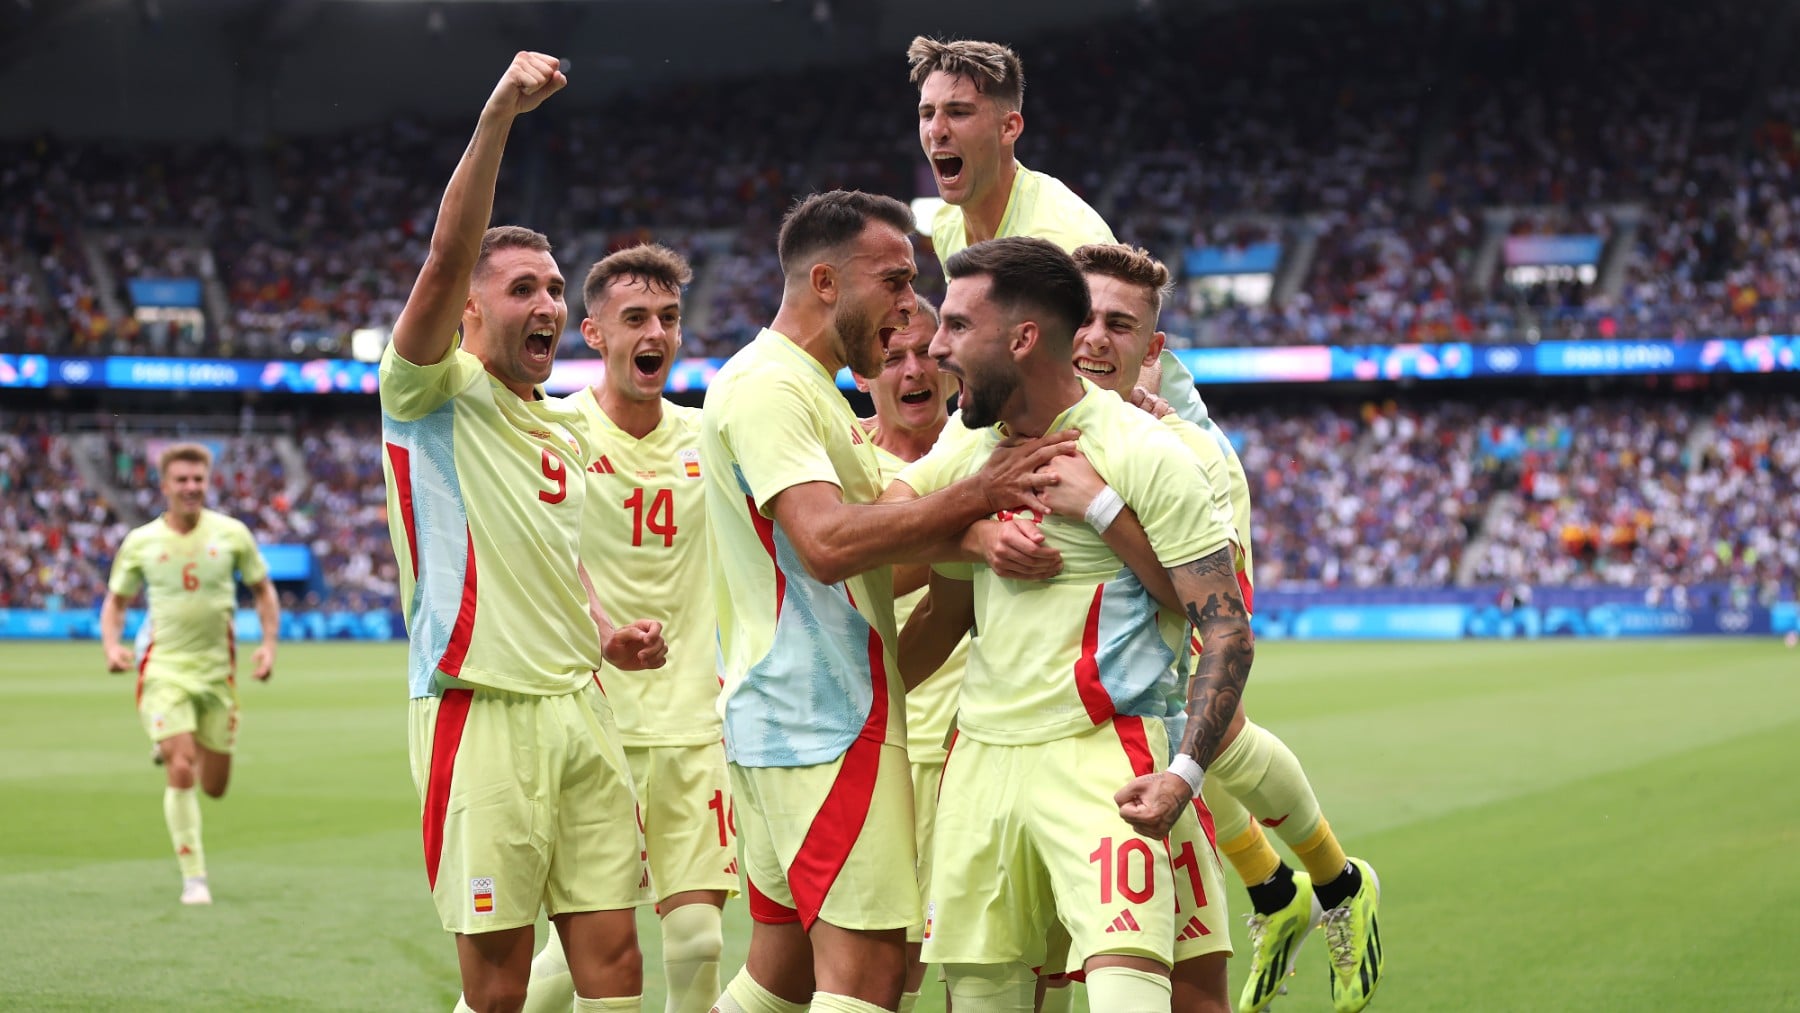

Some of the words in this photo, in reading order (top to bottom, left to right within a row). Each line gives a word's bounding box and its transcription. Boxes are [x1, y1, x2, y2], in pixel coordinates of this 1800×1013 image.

[538, 447, 567, 505] 9
[623, 487, 678, 548] 14
[182, 562, 201, 593] 6
[1089, 836, 1155, 905] 10
[1173, 840, 1208, 914] 1
